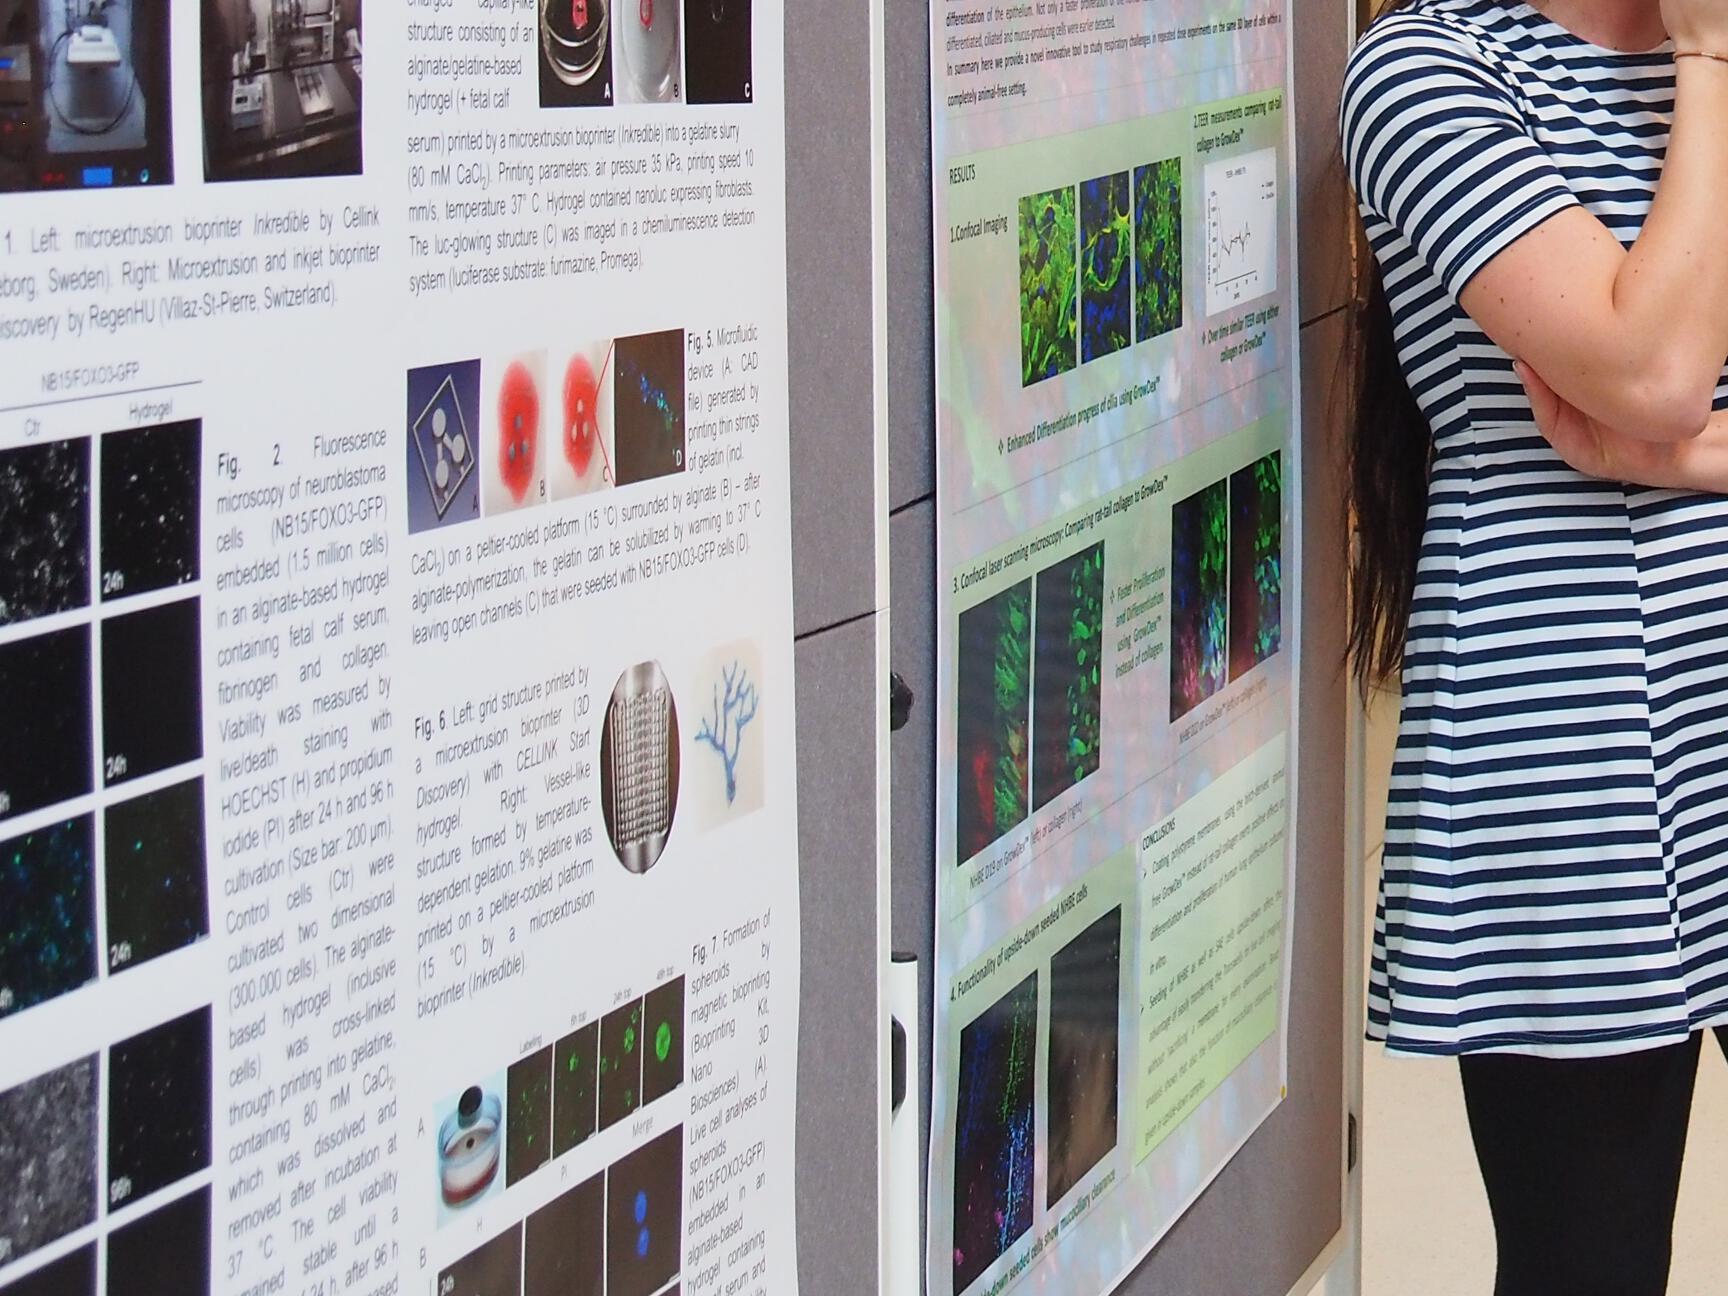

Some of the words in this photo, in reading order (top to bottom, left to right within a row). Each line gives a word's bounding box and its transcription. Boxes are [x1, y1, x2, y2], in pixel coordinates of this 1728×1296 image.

[408, 24, 453, 42] structure
[458, 24, 506, 45] consisting
[510, 23, 519, 42] of
[521, 27, 534, 42] an
[603, 83, 611, 99] A
[673, 83, 679, 98] B
[744, 83, 750, 98] C
[950, 164, 975, 184] RESULTS
[950, 218, 982, 243] 1.Confocal
[984, 214, 1007, 235] Imaging
[1007, 425, 1035, 452] Enhanced
[1037, 413, 1076, 440] Differentiation
[1078, 404, 1099, 428] progress
[1101, 397, 1106, 413] of
[1108, 393, 1118, 411] cilia
[1119, 389, 1132, 406] using
[217, 453, 241, 481] Fig.
[313, 428, 387, 459] Fluorescence
[961, 561, 987, 589] Confocal
[989, 558, 1003, 575] laser
[1004, 544, 1028, 568] scanning
[1065, 513, 1094, 537] Comparing
[1095, 501, 1112, 523] rat-tail
[1113, 494, 1133, 514] collagen
[1135, 490, 1140, 502] to
[414, 716, 435, 740] Fig.
[478, 695, 498, 722] grid
[501, 683, 542, 712] structure
[545, 671, 574, 700] printed
[577, 665, 589, 688] by
[1143, 817, 1175, 850] CONCLUSIONS
[692, 943, 707, 965] Fig.
[722, 915, 760, 947] Formation
[763, 907, 771, 929] of
[958, 959, 995, 998] Functionality
[997, 947, 1003, 967] of
[1004, 924, 1040, 962] upside-down
[1040, 904, 1059, 932] seeded
[1060, 892, 1076, 916] NHBE
[1076, 883, 1087, 904] cells
